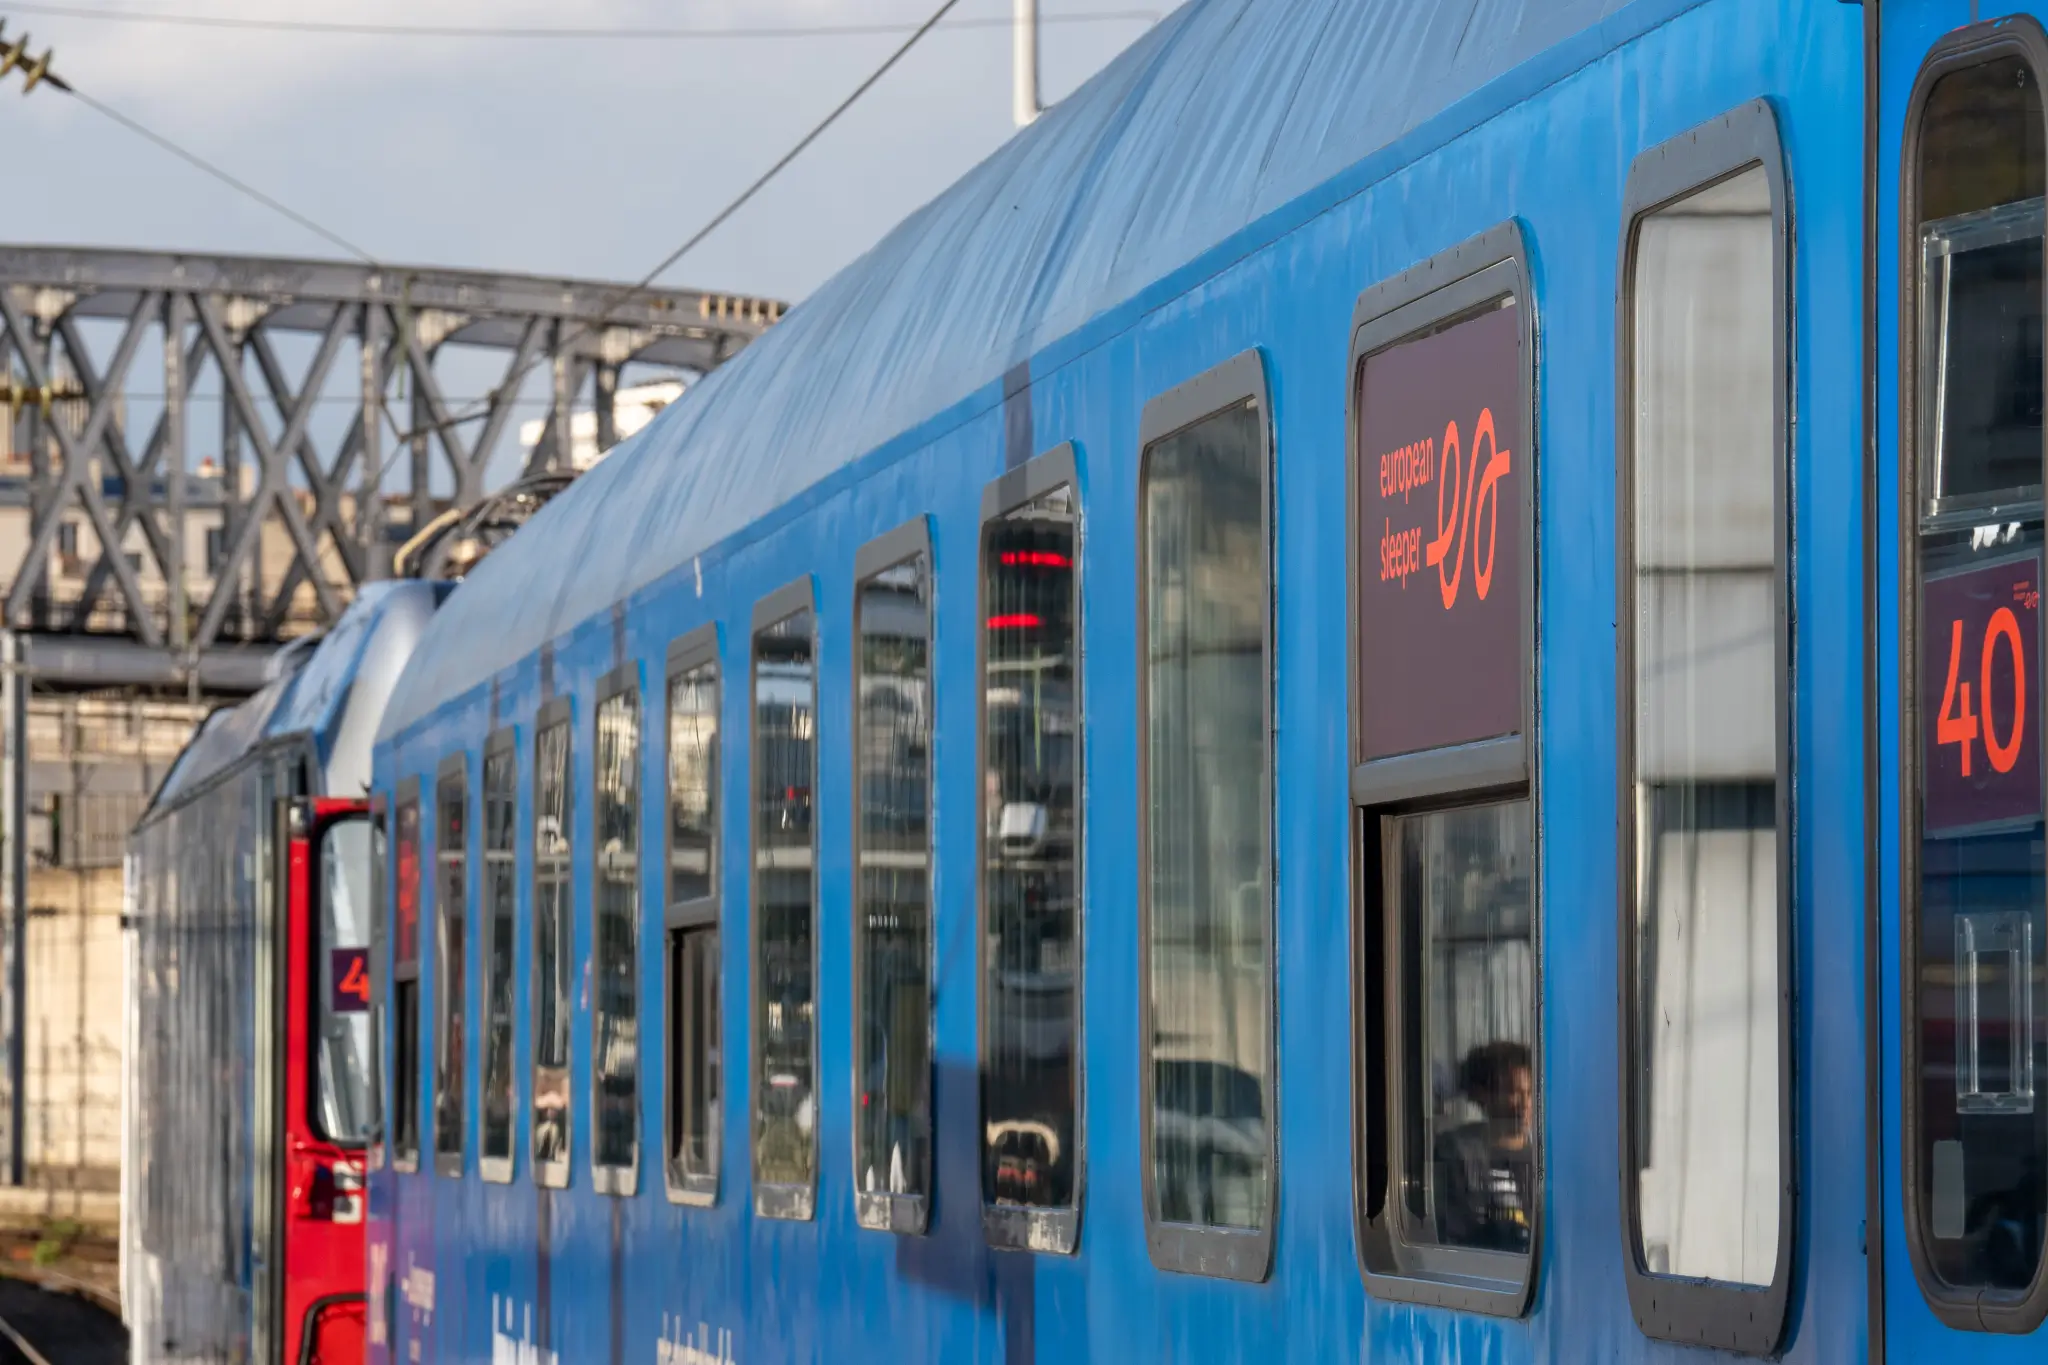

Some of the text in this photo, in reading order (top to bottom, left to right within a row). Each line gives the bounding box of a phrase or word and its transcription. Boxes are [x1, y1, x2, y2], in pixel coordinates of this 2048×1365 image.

[1380, 437, 1434, 504] european
[1380, 517, 1421, 589] sleeper
[1937, 607, 2025, 777] 40
